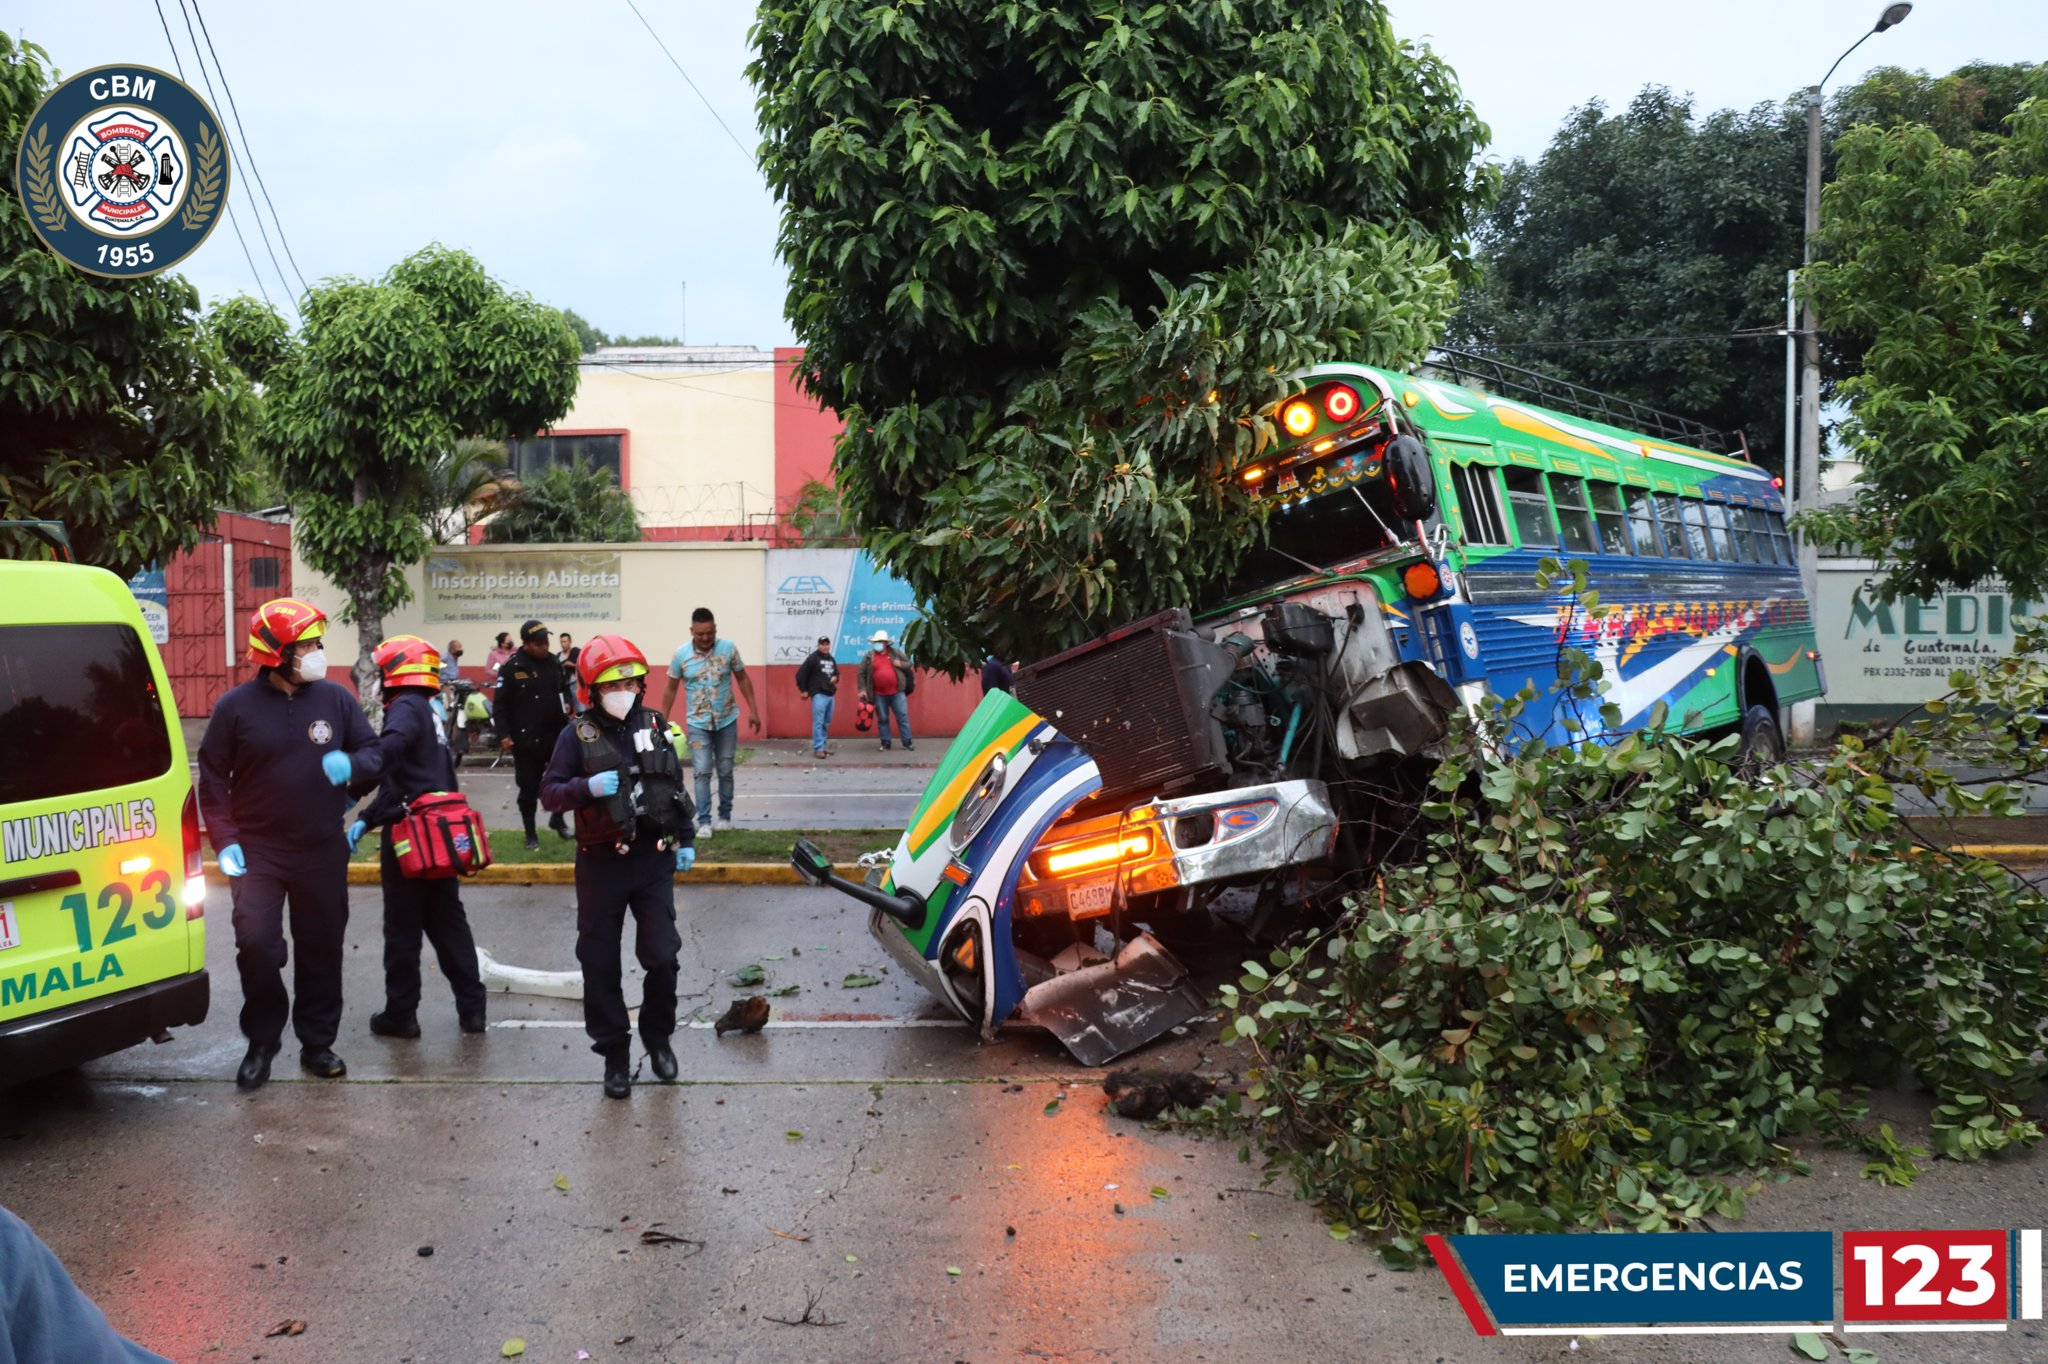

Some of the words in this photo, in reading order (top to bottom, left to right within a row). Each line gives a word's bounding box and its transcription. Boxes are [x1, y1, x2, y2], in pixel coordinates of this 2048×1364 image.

[431, 571, 540, 592] Inscripción
[544, 569, 620, 588] Abierta
[824, 598, 839, 606] for
[860, 616, 904, 624] Primaria
[843, 634, 864, 646] Tel:
[1863, 639, 1881, 653] de
[1916, 656, 1951, 665] AVENIDA
[1934, 668, 1946, 677] AL
[2, 798, 156, 863] MUNICIPALES
[60, 869, 176, 954] 123
[0, 953, 124, 1006] MALA
